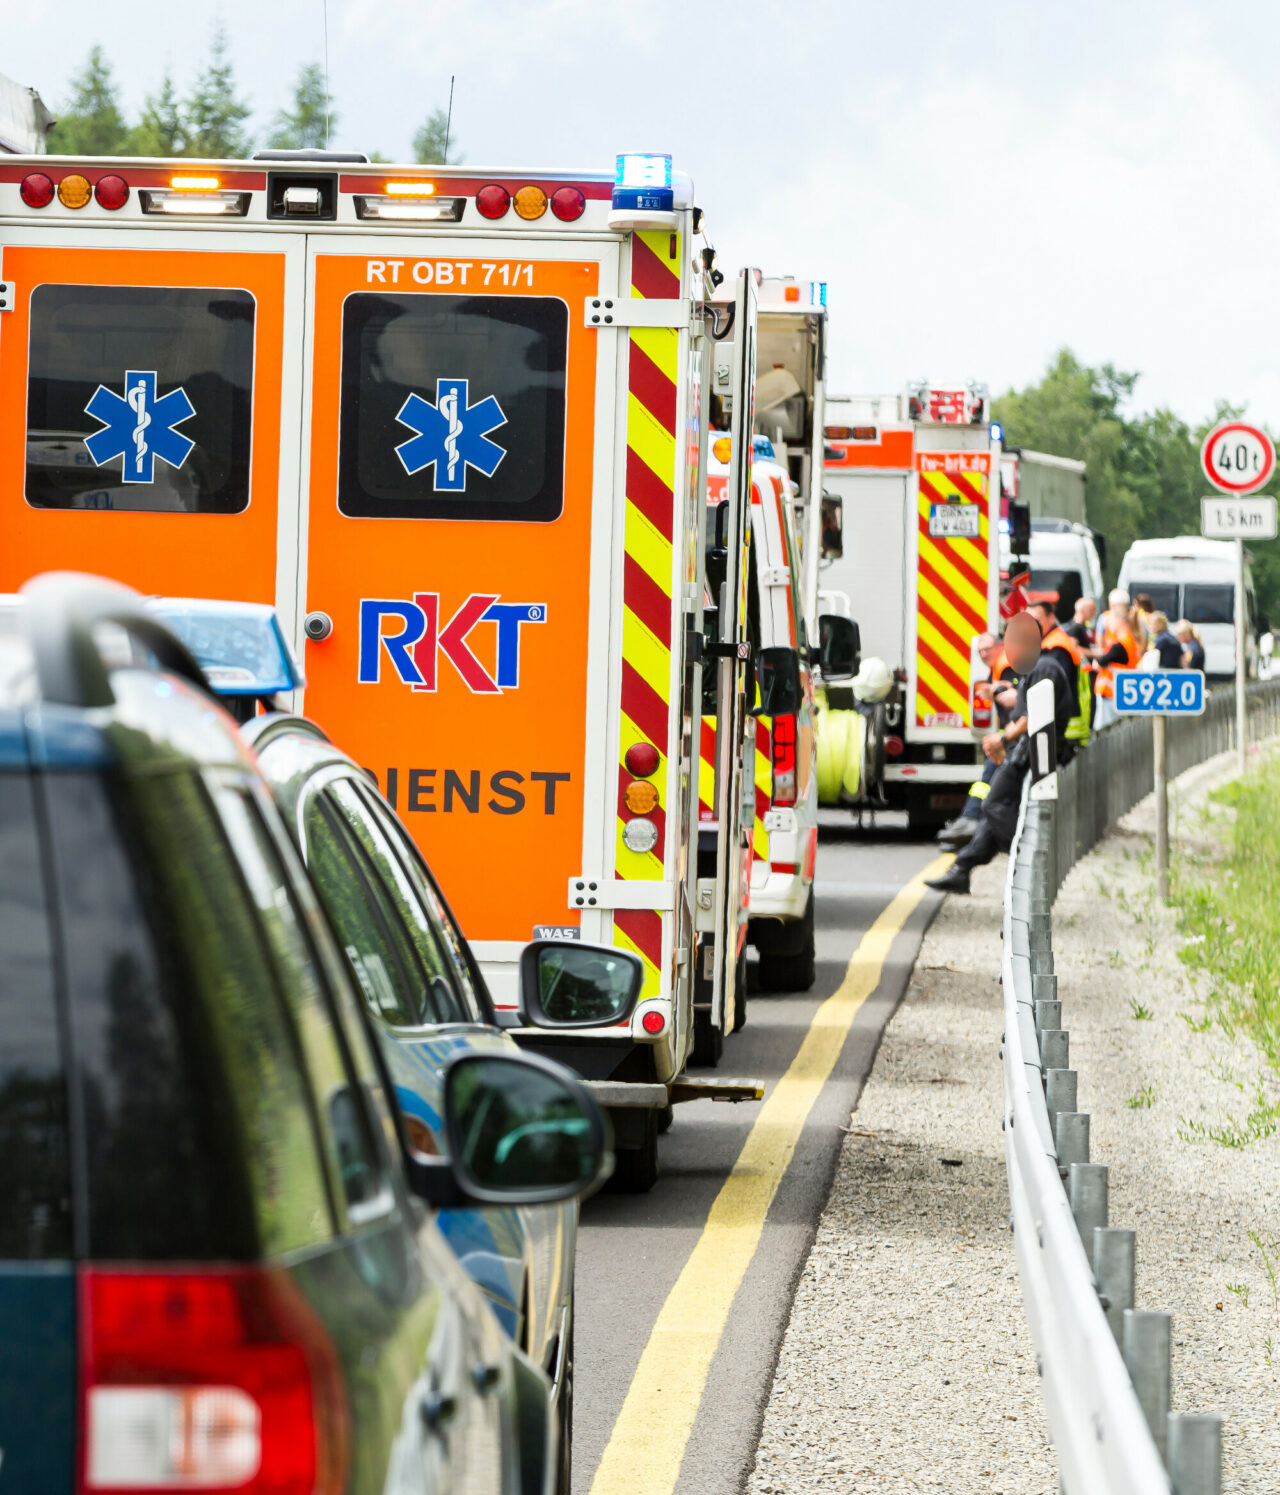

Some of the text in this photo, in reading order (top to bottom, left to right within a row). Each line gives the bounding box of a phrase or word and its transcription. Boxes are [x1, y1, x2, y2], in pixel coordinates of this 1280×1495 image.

[366, 261, 534, 286] RT OBT 71/1
[920, 455, 988, 472] fw-brk.de
[1219, 443, 1260, 471] 40 t
[1240, 509, 1263, 527] km
[538, 928, 574, 939] WAS
